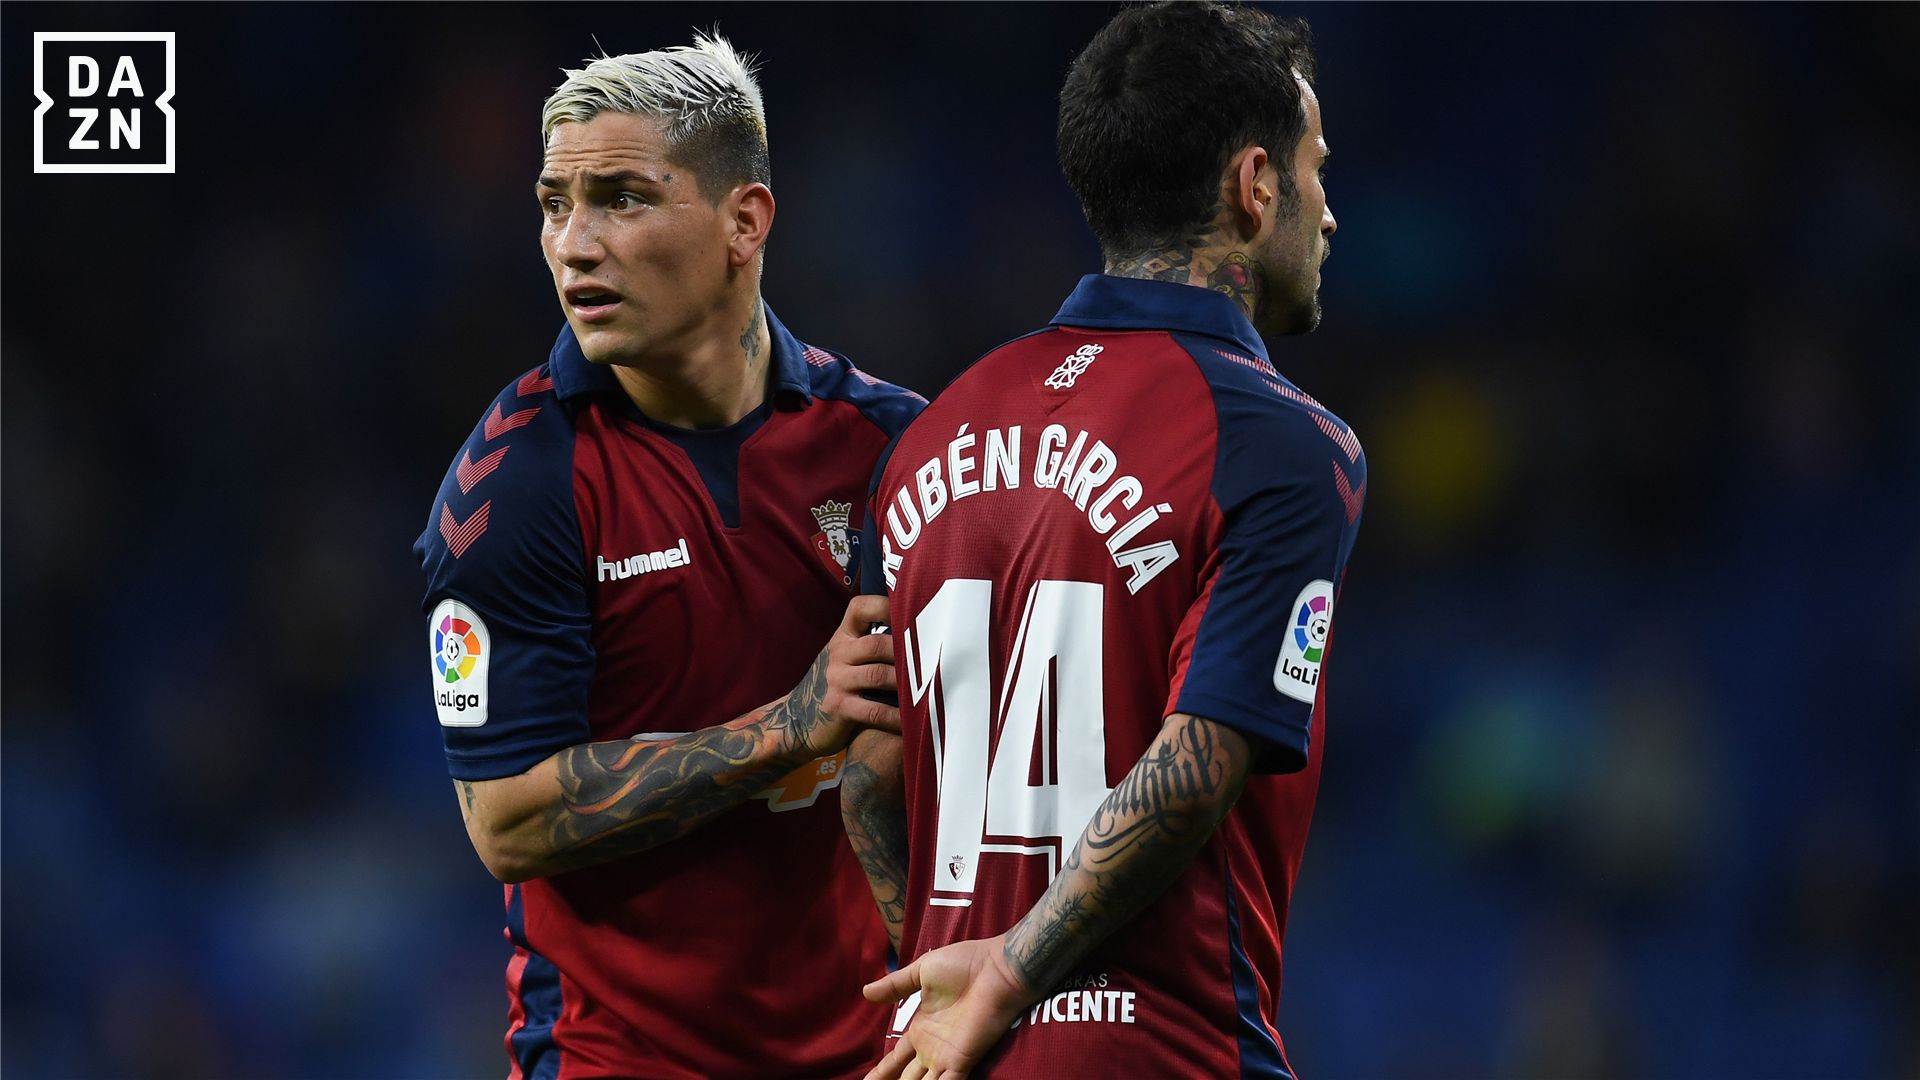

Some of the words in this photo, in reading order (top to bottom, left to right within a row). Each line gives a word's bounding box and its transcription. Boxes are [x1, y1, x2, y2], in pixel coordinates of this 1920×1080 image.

[597, 538, 691, 582] hummel
[882, 423, 1021, 591] RUBÉN
[1034, 423, 1180, 595] GARCÍA
[904, 578, 1115, 906] 14
